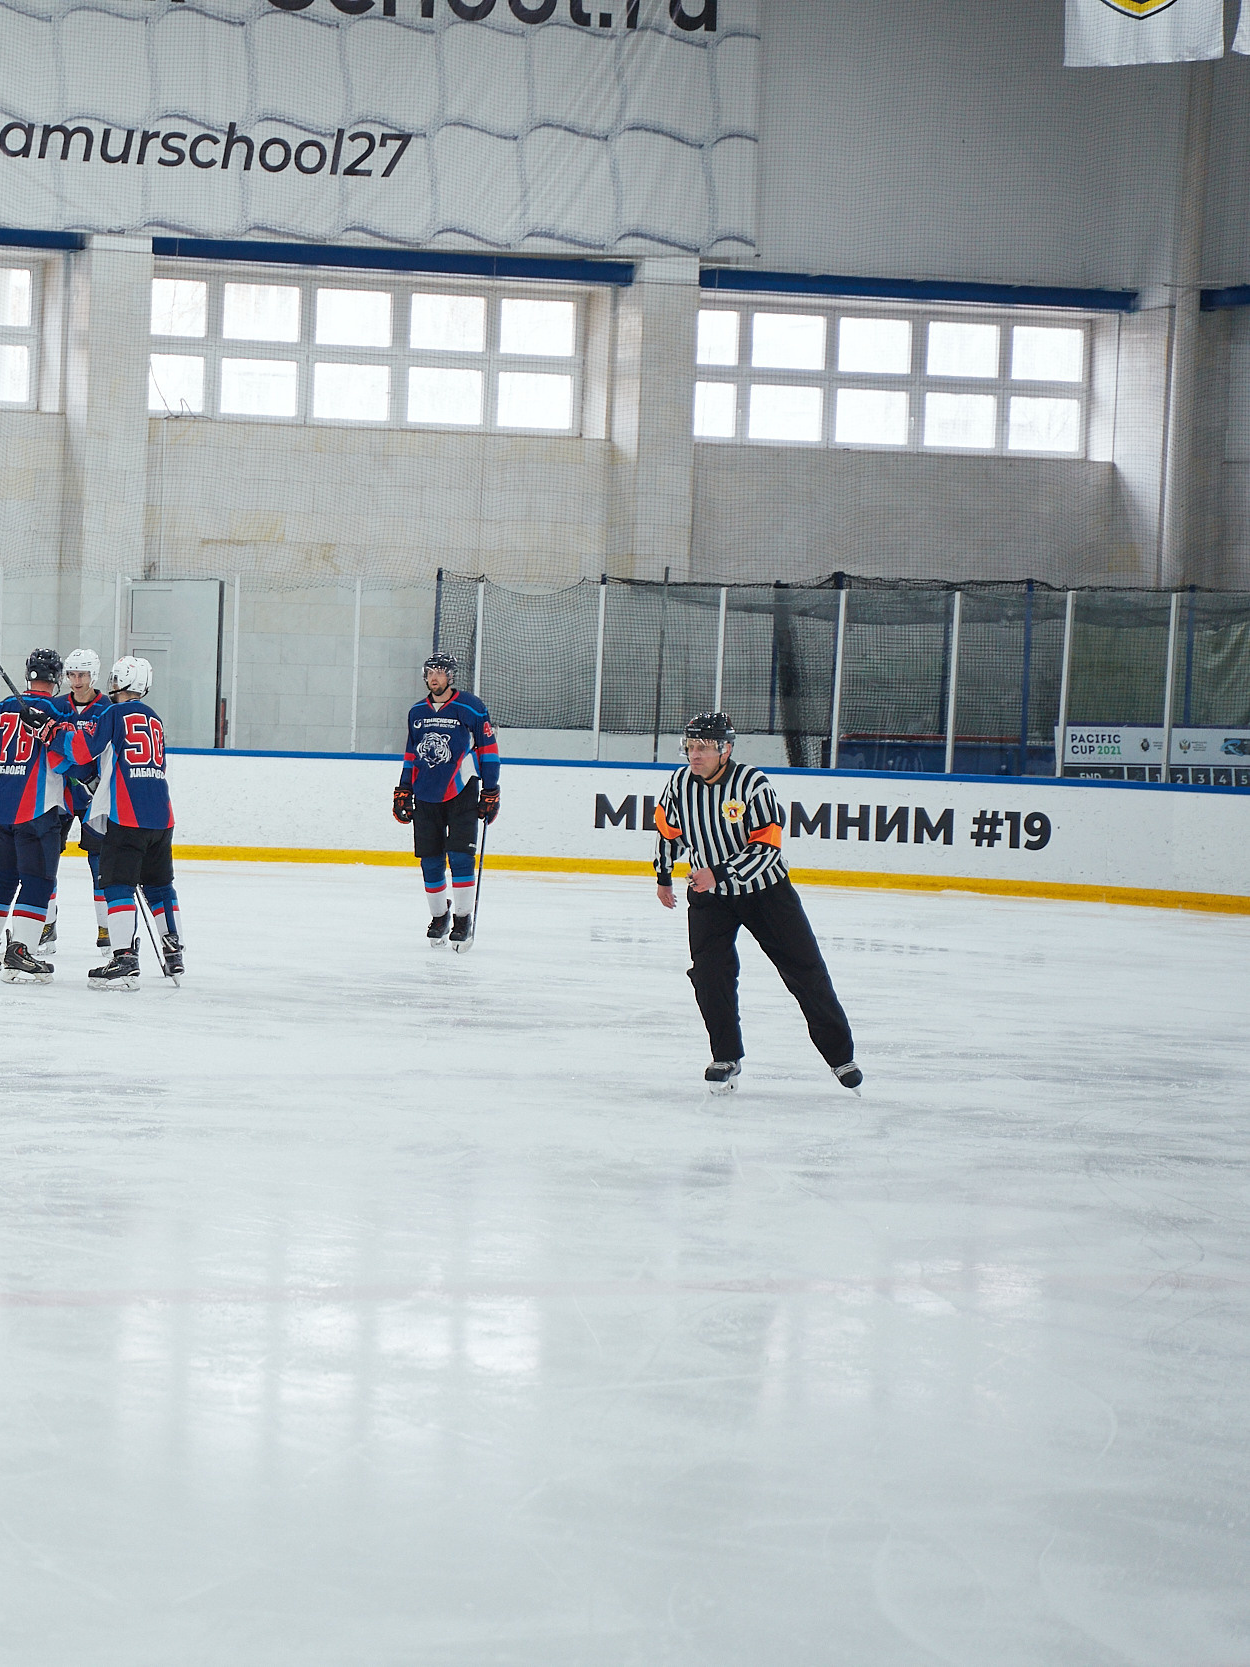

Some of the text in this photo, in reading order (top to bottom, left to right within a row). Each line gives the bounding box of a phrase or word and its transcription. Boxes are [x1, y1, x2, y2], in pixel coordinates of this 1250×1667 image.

[122, 712, 165, 767] 50
[1070, 734, 1121, 744] PACIFIC
[1071, 745, 1122, 755] CUP 2021
[1176, 774, 1184, 784] 2
[1197, 774, 1206, 784] 3
[1219, 775, 1227, 785] 4
[1241, 775, 1249, 785] 5
[777, 800, 955, 846] МНИМ
[970, 809, 1052, 851] #19
